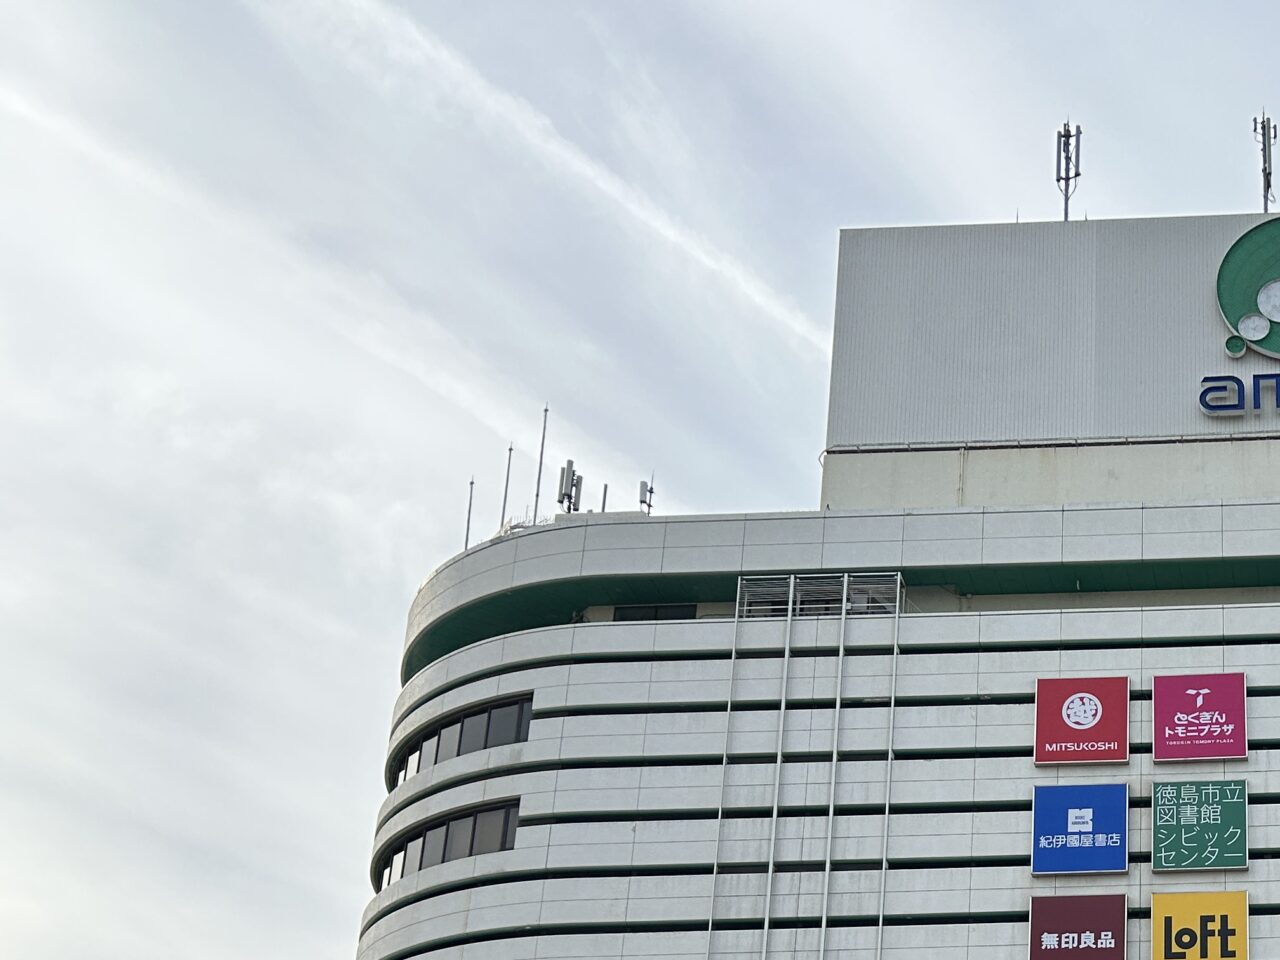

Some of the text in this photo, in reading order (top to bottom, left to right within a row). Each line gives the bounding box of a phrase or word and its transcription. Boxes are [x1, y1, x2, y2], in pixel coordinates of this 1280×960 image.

[1174, 711, 1227, 725] とくぎん
[1165, 724, 1235, 738] トモニプラザ
[1045, 741, 1118, 752] MITSUKOSHI
[1156, 784, 1243, 805] 徳島市立
[1156, 805, 1221, 825] 図書館
[1039, 833, 1120, 848] 紀伊國屋書店
[1156, 826, 1242, 846] シビック
[1156, 846, 1243, 866] センター
[1041, 931, 1115, 949] 無印良品
